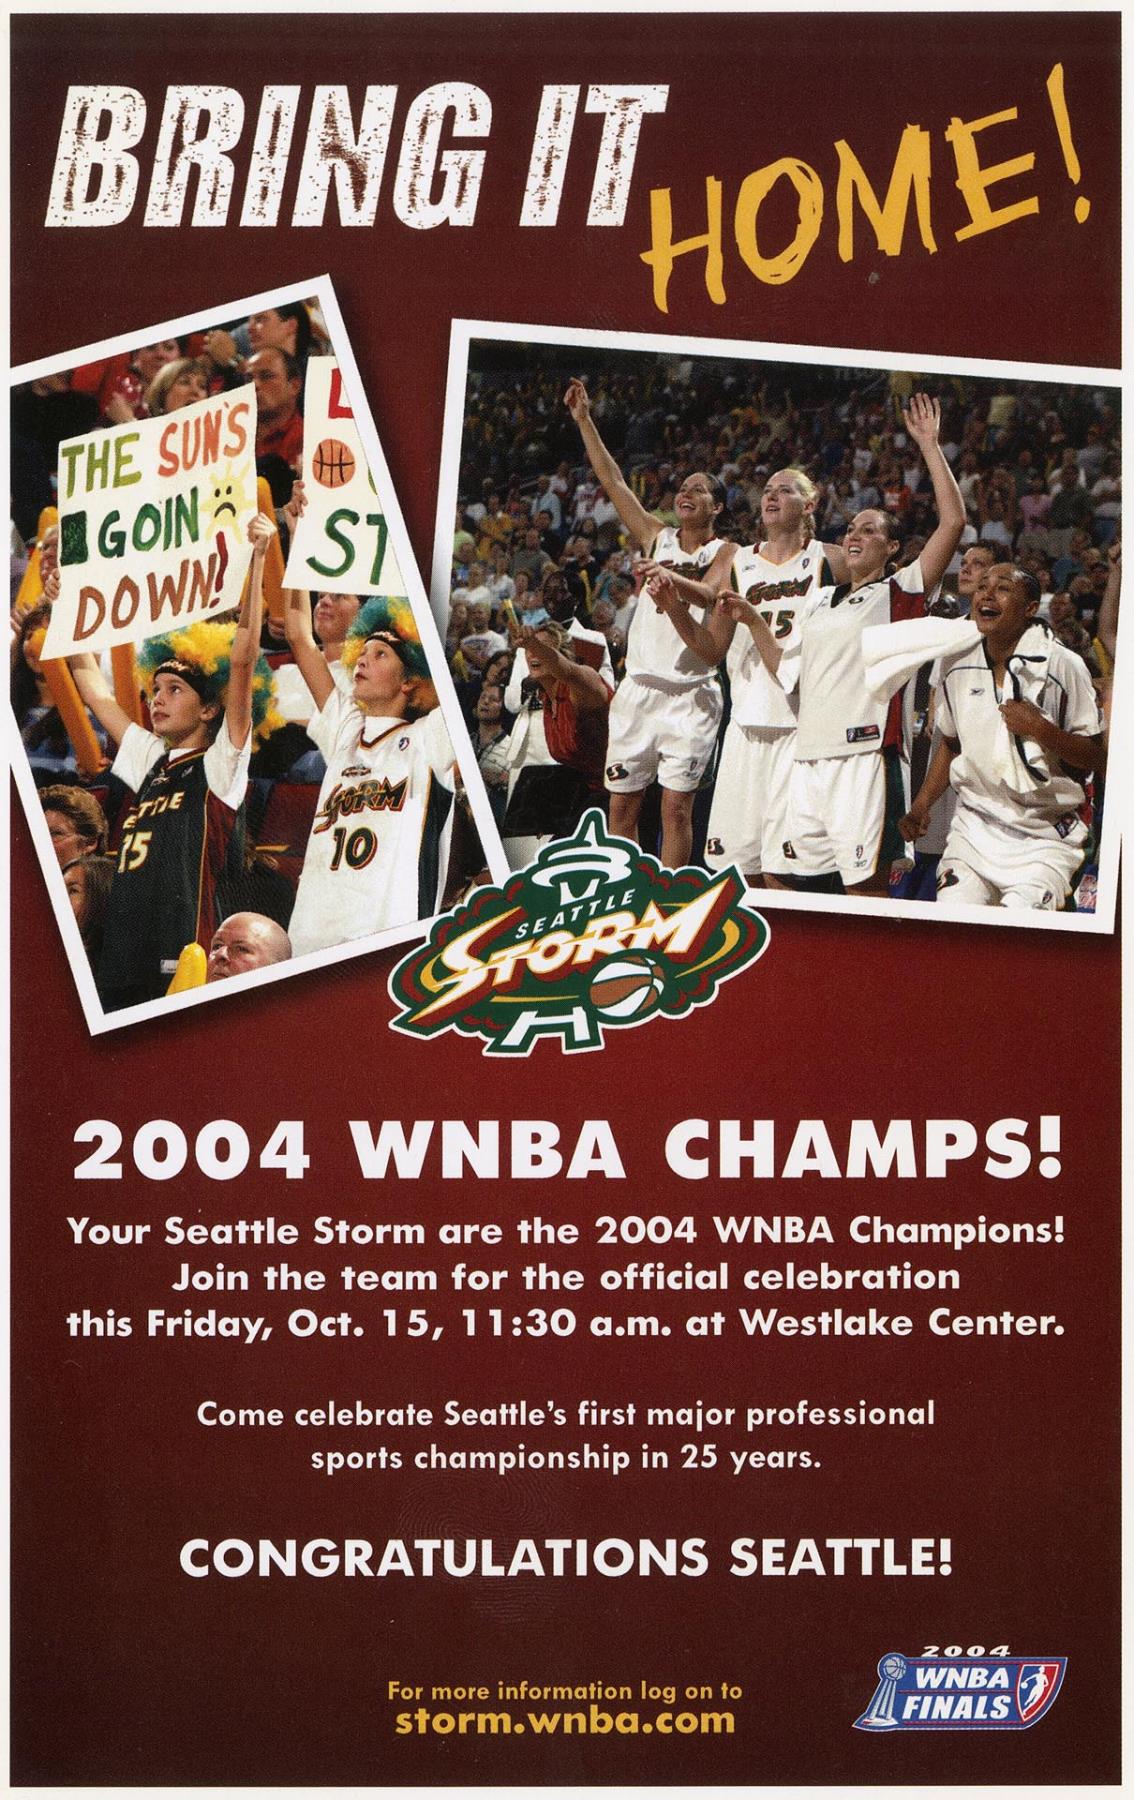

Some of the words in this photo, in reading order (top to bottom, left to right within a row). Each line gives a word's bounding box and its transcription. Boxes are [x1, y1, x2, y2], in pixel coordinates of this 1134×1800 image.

[44, 82, 493, 230] BRING
[519, 84, 671, 227] IT
[639, 62, 1091, 314] HOME!
[61, 431, 143, 499] THE
[157, 401, 250, 478] SUN'S
[98, 485, 200, 559] GOIN
[72, 530, 229, 642] DOWN!
[117, 830, 153, 874] 15
[329, 827, 379, 871] 10
[514, 888, 637, 940] SEATTLE
[407, 876, 736, 1024] STORM
[74, 1120, 312, 1182] 2004
[349, 1120, 628, 1180] WNBA
[665, 1116, 1063, 1181] CHAMPS!
[67, 1217, 152, 1246] Your
[165, 1217, 300, 1246] Seattle
[314, 1216, 426, 1246] Storm
[439, 1225, 504, 1246] are
[517, 1217, 580, 1246] the
[596, 1216, 699, 1245] 2004
[713, 1216, 836, 1245] WNBA
[850, 1216, 1066, 1252] Champions!
[172, 1263, 250, 1292] Join
[264, 1264, 327, 1292] the
[341, 1267, 439, 1292] team
[452, 1263, 510, 1292] for
[522, 1263, 586, 1292] the
[601, 1262, 729, 1292] official
[744, 1262, 961, 1291] celebration
[67, 1309, 134, 1338] this
[148, 1309, 274, 1345] Friday,
[288, 1309, 365, 1339] Oct.
[384, 1310, 445, 1342] 15,
[463, 1308, 578, 1338] 11:30
[590, 1317, 673, 1338] a.m.
[686, 1312, 727, 1338] at
[739, 1309, 914, 1338] Westlake
[929, 1308, 1066, 1337] Center.
[198, 1401, 285, 1427] Come
[295, 1401, 435, 1427] celebrate
[445, 1401, 568, 1427] Seattle’s
[578, 1401, 637, 1427] first
[648, 1400, 737, 1433] major
[748, 1400, 936, 1433] professional
[312, 1447, 404, 1477] sports
[415, 1444, 631, 1477] championship
[642, 1444, 670, 1470] in
[681, 1444, 719, 1470] 25
[730, 1452, 822, 1476] years.
[180, 1538, 710, 1579] CONGRATULATIONS
[730, 1538, 953, 1578] SEATTLE!
[920, 1645, 1012, 1658] 2004
[389, 1682, 425, 1701] For
[432, 1688, 491, 1701] more
[499, 1681, 633, 1701] information
[642, 1681, 677, 1705] log
[686, 1687, 714, 1700] on
[722, 1683, 744, 1700] to
[915, 1667, 1010, 1689] WNBA
[397, 1705, 736, 1735] storm.wnba.com
[902, 1695, 1013, 1721] FINALS
